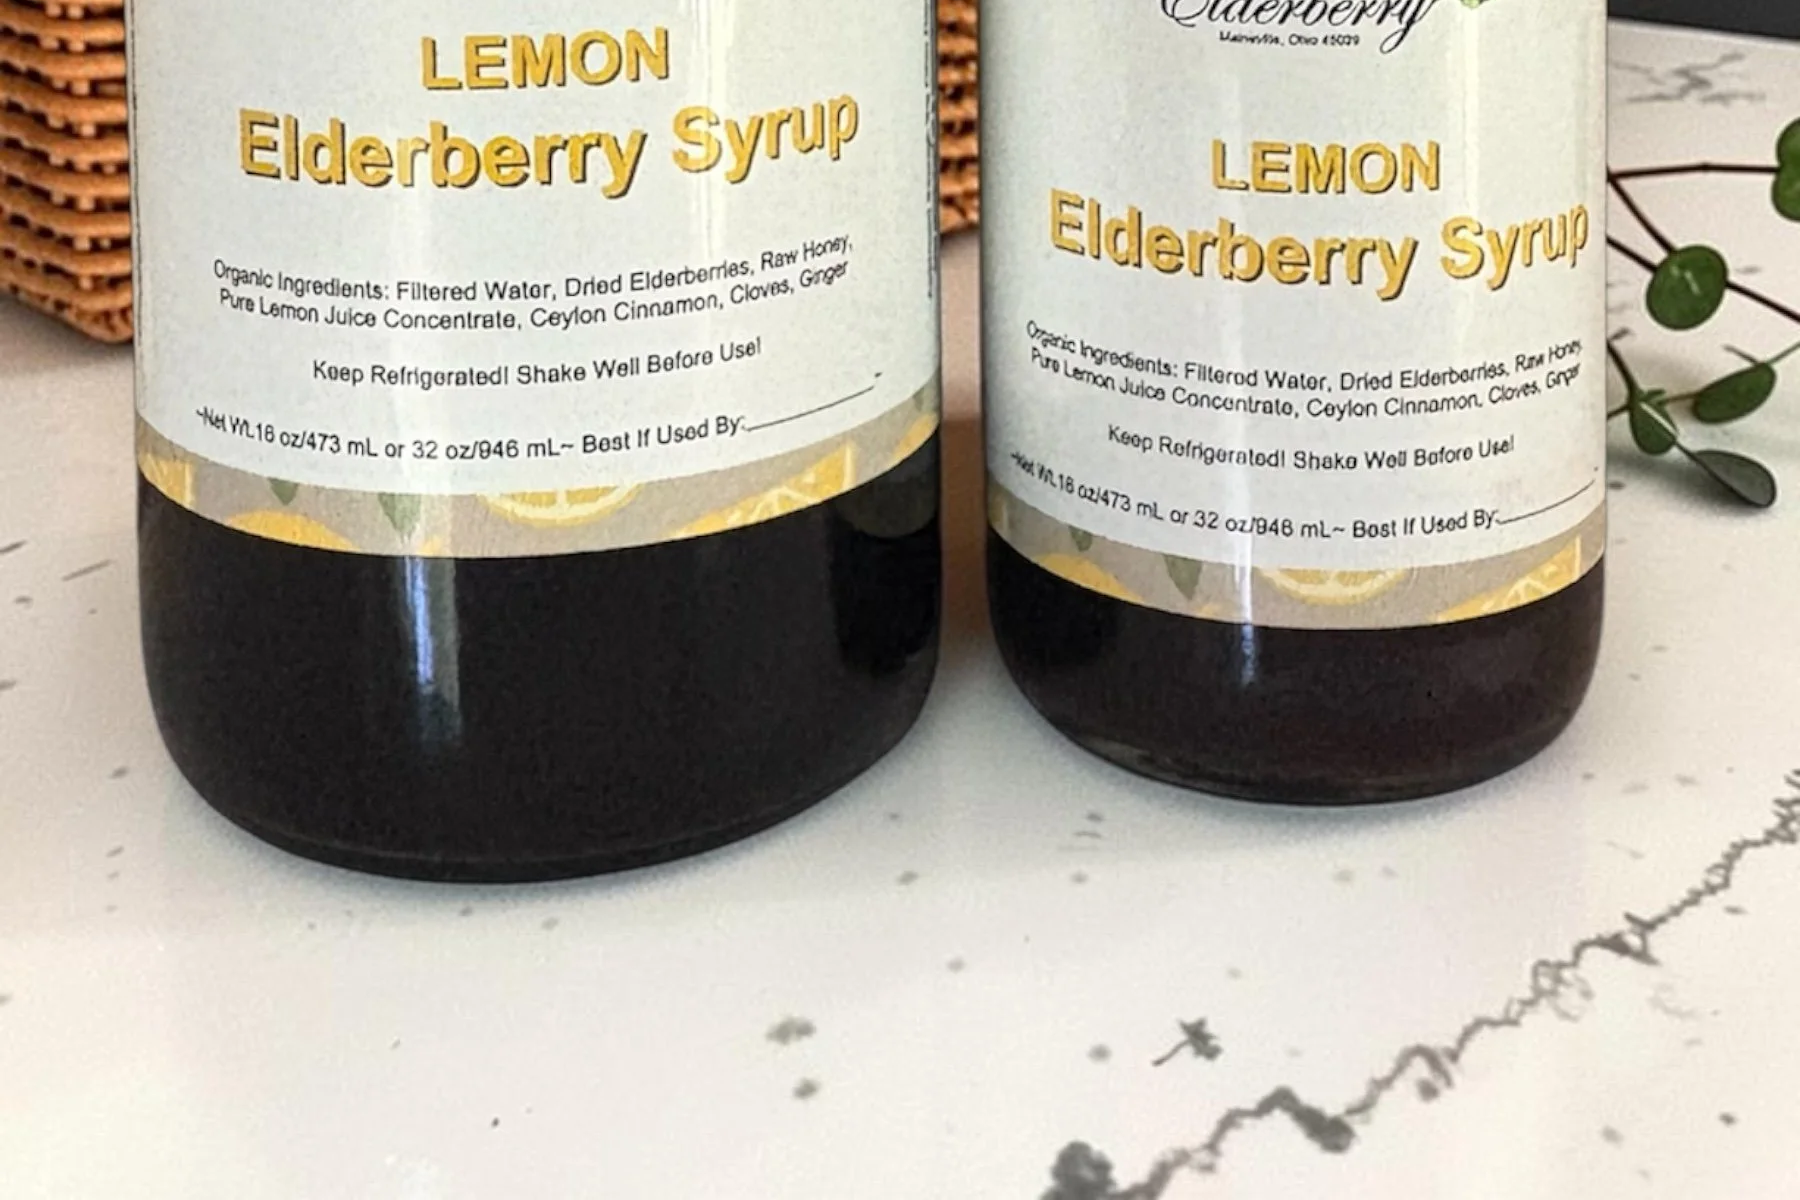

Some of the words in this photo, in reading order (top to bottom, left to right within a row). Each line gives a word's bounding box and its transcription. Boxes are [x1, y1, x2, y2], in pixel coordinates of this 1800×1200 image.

[420, 26, 670, 90] LEMON
[238, 106, 648, 199] Elderberry
[671, 93, 859, 183] Syrup
[1211, 139, 1440, 194] LEMON
[214, 258, 274, 289] Organic
[278, 270, 390, 300] Ingredients:
[396, 280, 477, 302] Filtered
[485, 281, 557, 302] Water,
[565, 275, 623, 298] Dried
[630, 259, 756, 292] Elderberries,
[761, 249, 799, 272] Raw
[803, 234, 853, 262] Honey,
[1049, 187, 1419, 302] Elderberry
[1439, 203, 1589, 291] Syrup
[220, 288, 255, 313] Pure
[260, 295, 320, 324] Lemon
[325, 307, 377, 328] Juice
[384, 308, 522, 331] Concentrate,
[530, 307, 607, 331] Ceylon
[614, 291, 725, 321] Cinnamon,
[730, 277, 795, 305] Cloves,
[800, 260, 849, 288] Ginger
[313, 359, 364, 386] Keep
[370, 364, 509, 391] Refrigerated!
[516, 364, 586, 385] Shake
[593, 357, 640, 379] Well
[648, 349, 714, 374] Before
[720, 336, 762, 362] Use!
[1027, 320, 1077, 354] Organic
[1080, 339, 1179, 378] Ingredients:
[1185, 362, 1258, 388] Filtered
[1265, 370, 1332, 393] Water,
[1340, 371, 1393, 392] Dried
[1400, 362, 1510, 390] Elderberries,
[1515, 352, 1545, 373] Raw
[1031, 347, 1061, 374] Pure
[1063, 361, 1116, 391] Lemon
[1119, 377, 1166, 402] Juice
[1172, 386, 1300, 419] Concentrate,
[1307, 397, 1378, 421] Ceylon
[1384, 390, 1484, 417] Cinnamon,
[1488, 380, 1542, 405] Cloves,
[279, 430, 341, 454] oz/473
[348, 436, 378, 458] mL
[384, 441, 404, 458] or
[411, 439, 438, 459] 32
[445, 440, 519, 460] oz/946
[582, 432, 631, 454] Best
[637, 427, 651, 448] If
[656, 418, 710, 445] Used
[1108, 423, 1154, 453] Keep
[1158, 434, 1286, 469] Refrigerated!
[1293, 449, 1358, 471] Shake
[1364, 450, 1408, 469] Well
[1413, 445, 1474, 467] Before
[1478, 433, 1515, 457] Use!
[1077, 483, 1132, 513] oz/473
[1136, 500, 1165, 521] mL
[1170, 508, 1189, 525] or
[1192, 509, 1220, 530] 32
[1225, 516, 1294, 537] oz/946
[1352, 519, 1397, 539] Best
[1403, 516, 1417, 535] If
[1421, 511, 1468, 535] Used
